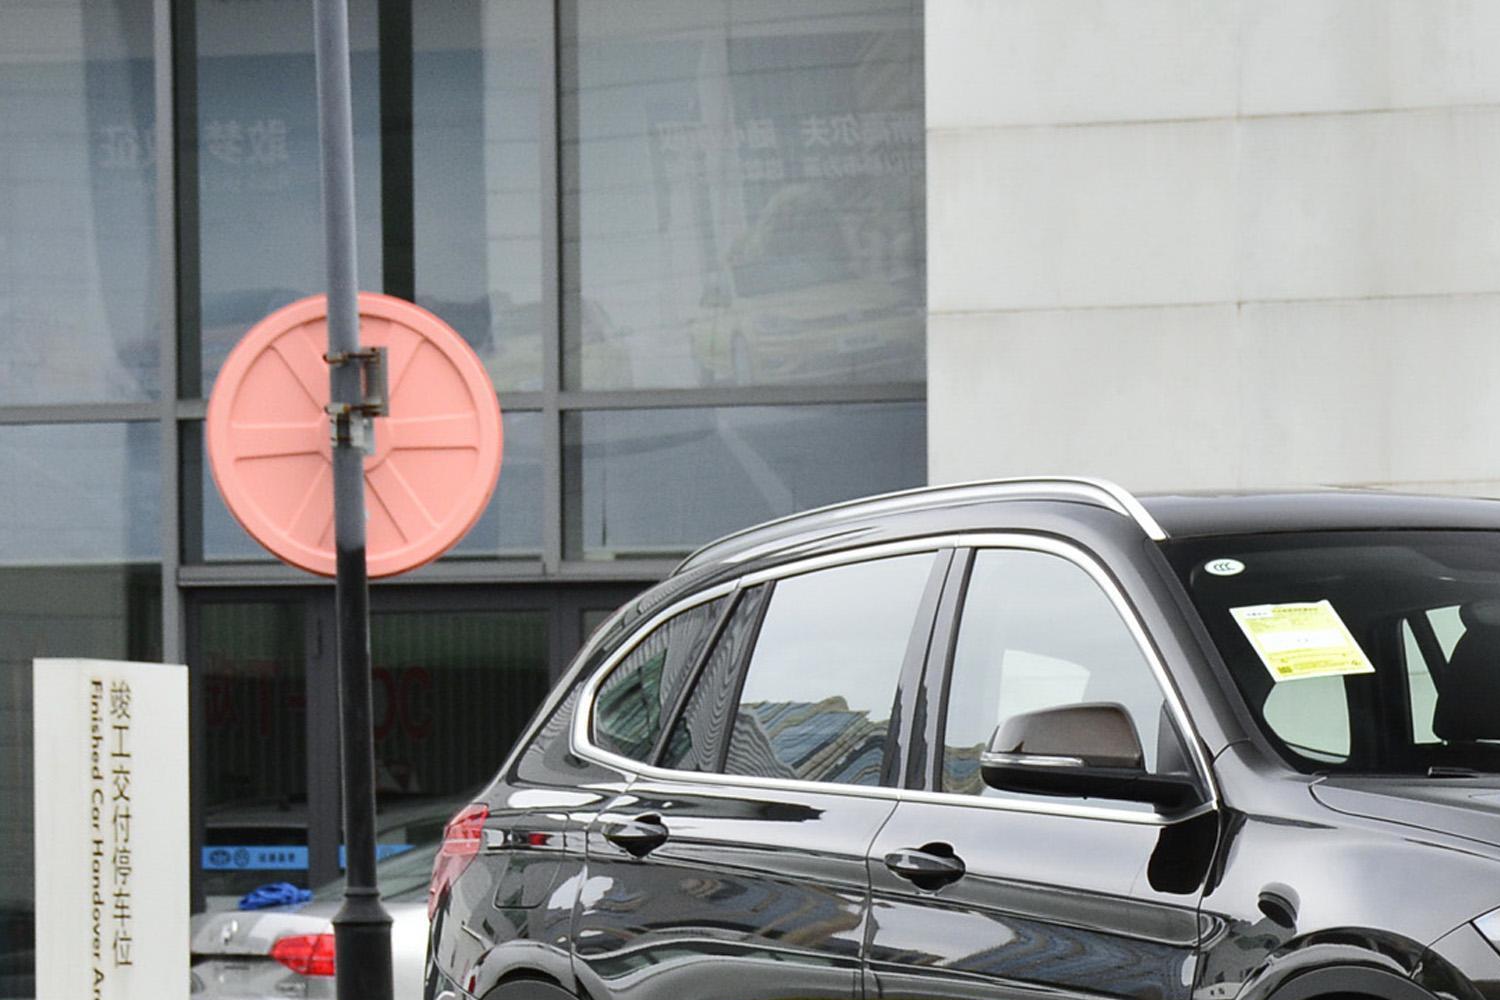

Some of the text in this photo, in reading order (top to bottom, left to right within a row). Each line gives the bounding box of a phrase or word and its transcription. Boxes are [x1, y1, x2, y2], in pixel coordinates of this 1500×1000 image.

[91, 680, 103, 780] Finished
[91, 788, 104, 829] Car
[110, 680, 133, 967] 竣工交付停车位
[92, 839, 104, 957] Handover
